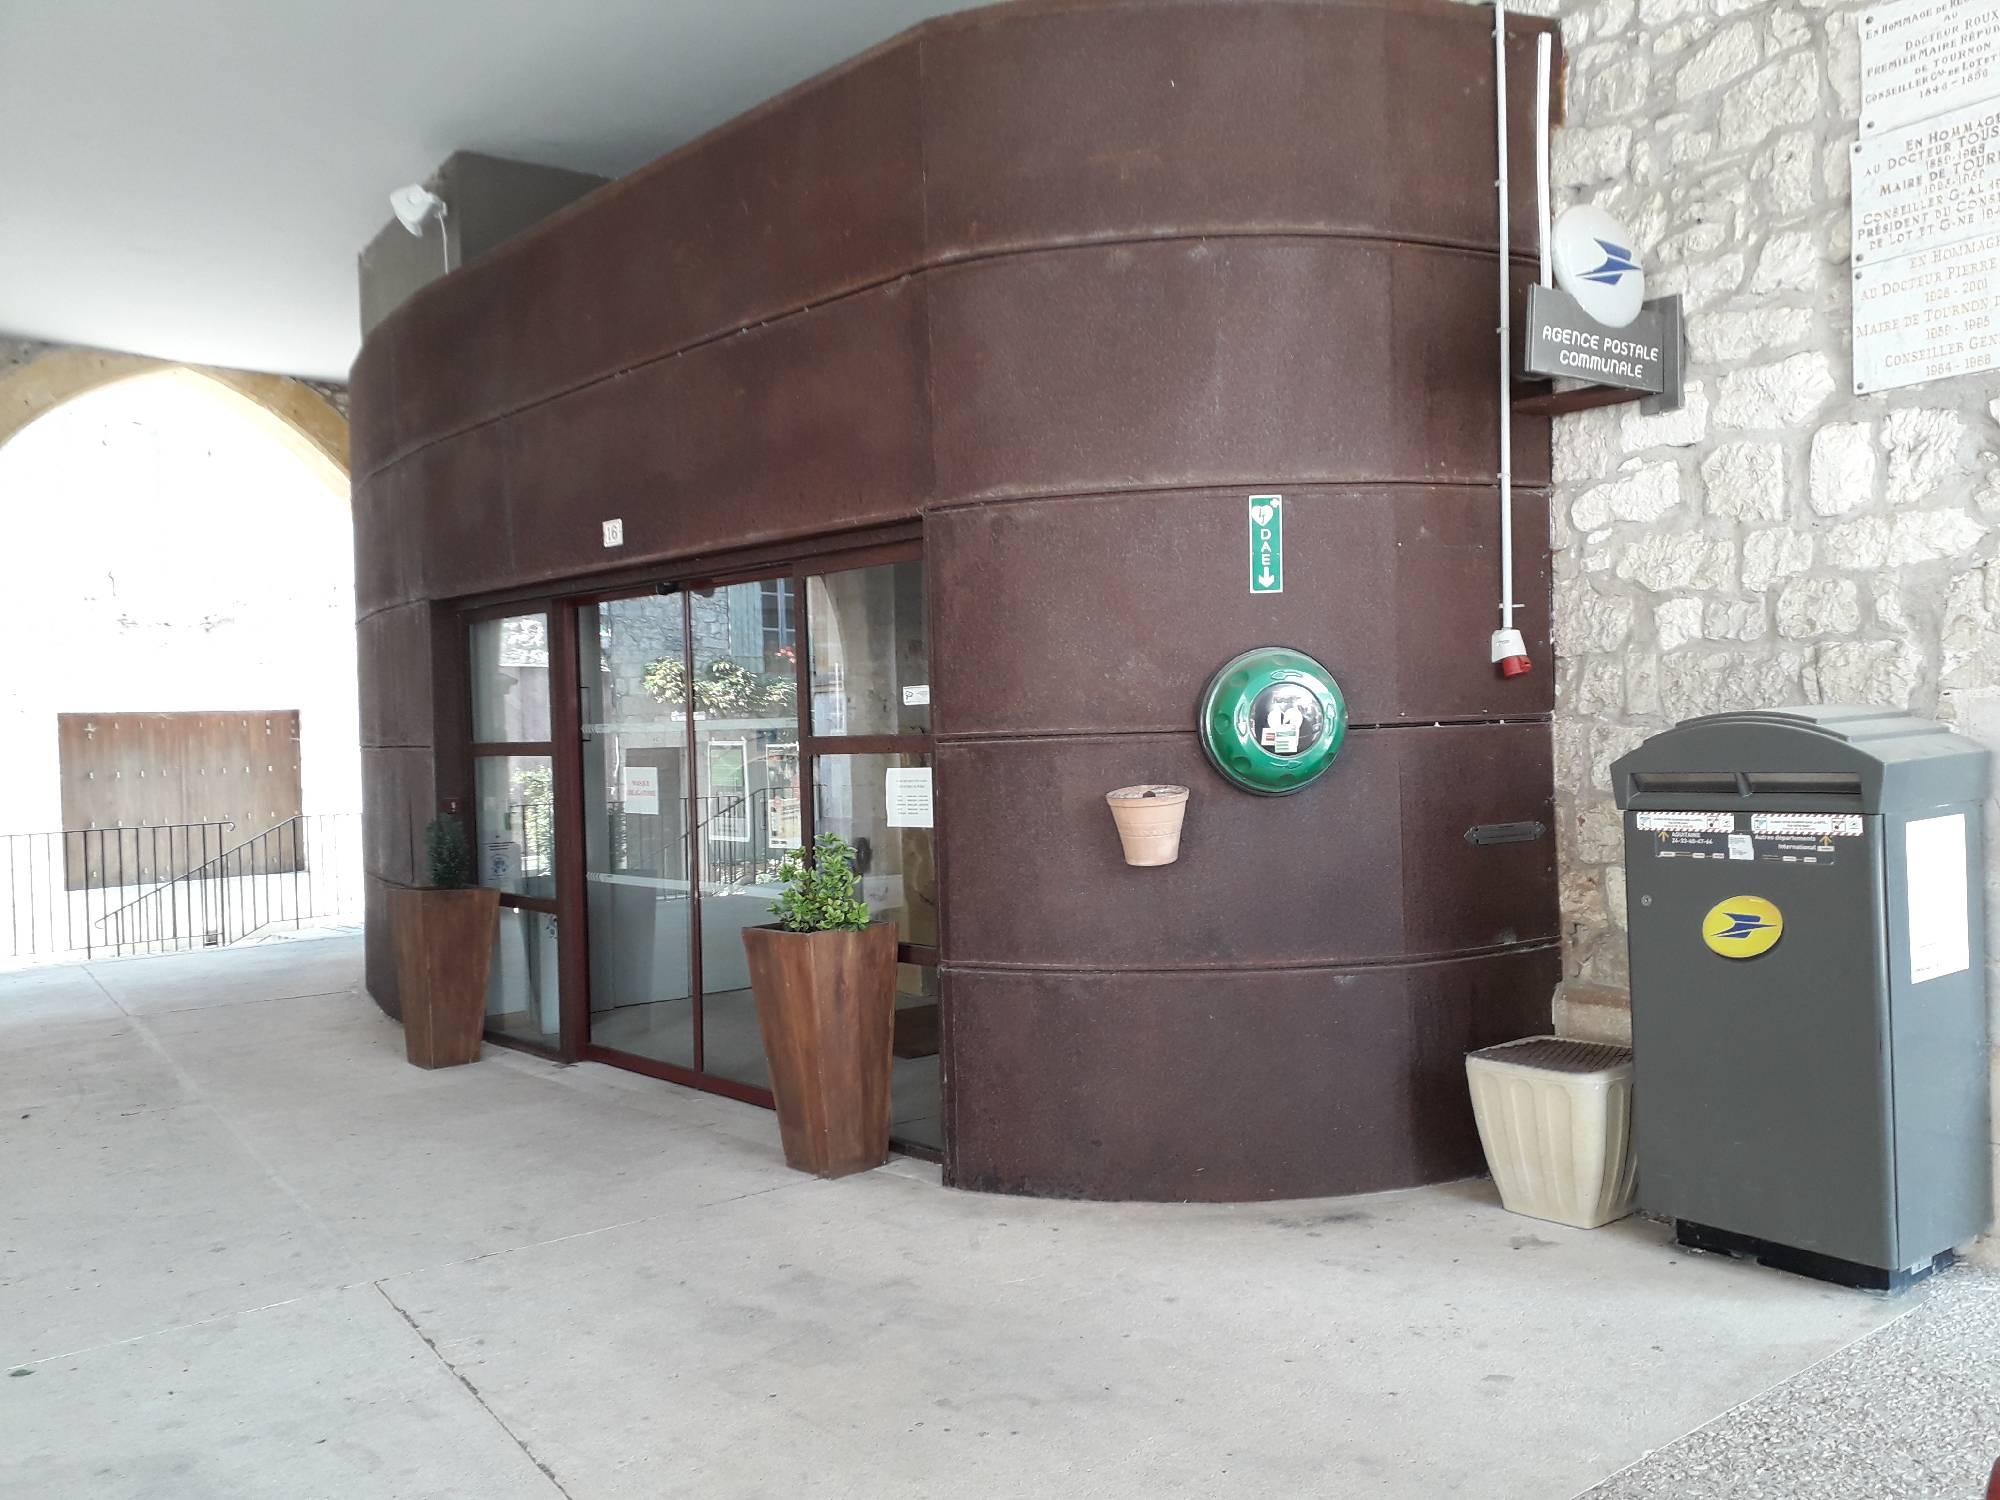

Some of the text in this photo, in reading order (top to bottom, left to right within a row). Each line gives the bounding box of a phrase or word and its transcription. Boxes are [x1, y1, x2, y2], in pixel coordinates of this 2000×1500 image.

[1882, 8, 1932, 34] HOMMAGE
[1905, 9, 1999, 51] DOCTEUR ROUX
[1867, 53, 1917, 77] PREMIER
[1919, 40, 1957, 60] MAIRE
[1915, 41, 1991, 75] DE TOURNON
[1865, 75, 1929, 104] CONSEILLER
[1906, 138, 1922, 151] EN
[1866, 163, 1880, 178] AU
[1888, 142, 1951, 170] DOCTEUR
[1880, 175, 1921, 197] MAIRE
[1929, 168, 1945, 181] DE
[1858, 192, 2000, 240] PRÉSIDENT DU CONS
[1864, 194, 1943, 224] CONSEILLER
[1870, 238, 1882, 250] DE
[1890, 230, 1912, 245] LOT
[1920, 223, 1934, 236] ET
[1910, 254, 1926, 269] EN
[1860, 257, 1997, 300] AU DOCTEUR PIERRE
[1962, 278, 1988, 294] 2001
[1856, 319, 1898, 338] MAIRE
[1904, 314, 1919, 327] DE
[1924, 297, 1988, 322] TOURNON
[1542, 325, 1659, 361] AGENCE POSTALE
[1885, 342, 1964, 368] CONSEILLER
[1559, 349, 1643, 378] COMMUNALE
[1260, 528, 1271, 566] DAE
